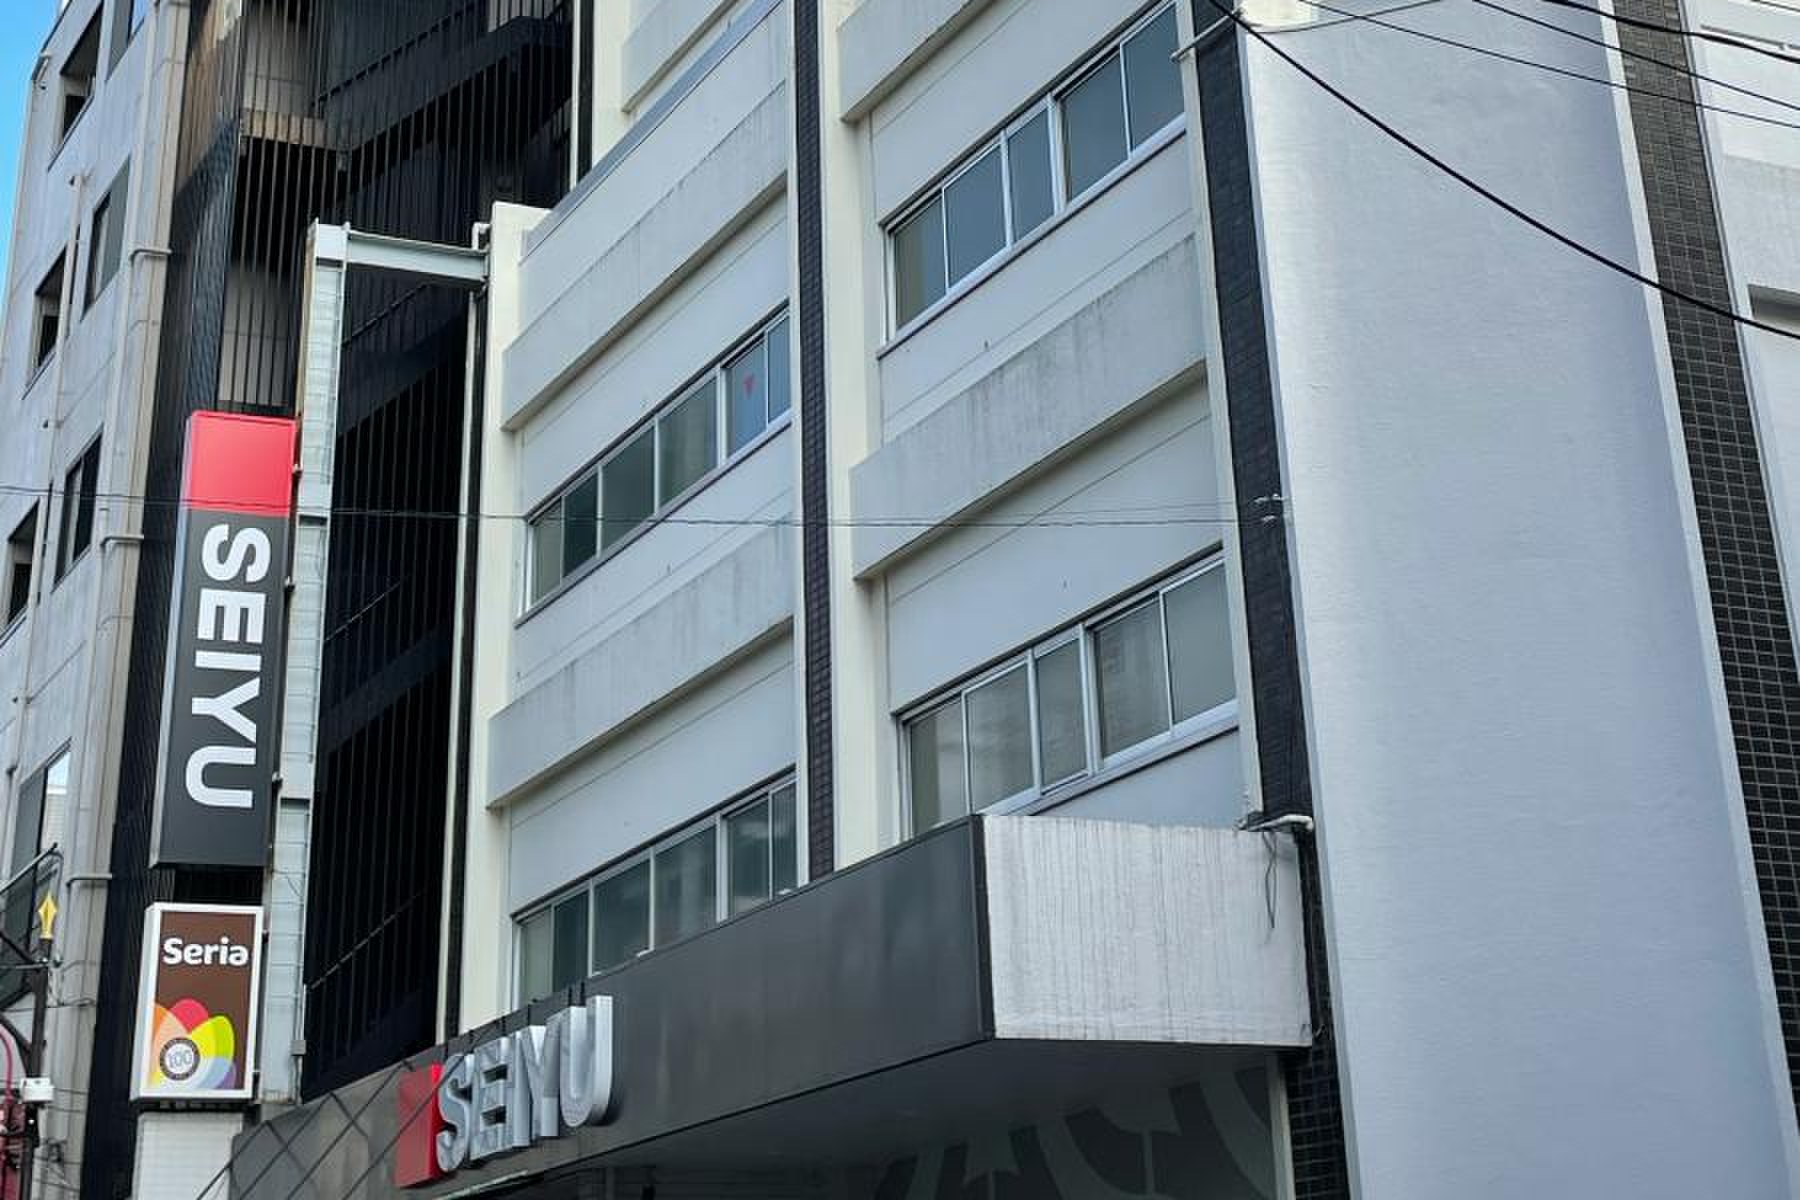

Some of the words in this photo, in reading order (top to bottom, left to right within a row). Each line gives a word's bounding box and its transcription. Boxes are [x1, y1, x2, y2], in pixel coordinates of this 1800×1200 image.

[185, 524, 272, 809] SEIYU
[163, 936, 249, 967] Seria
[435, 996, 613, 1172] SEIYU
